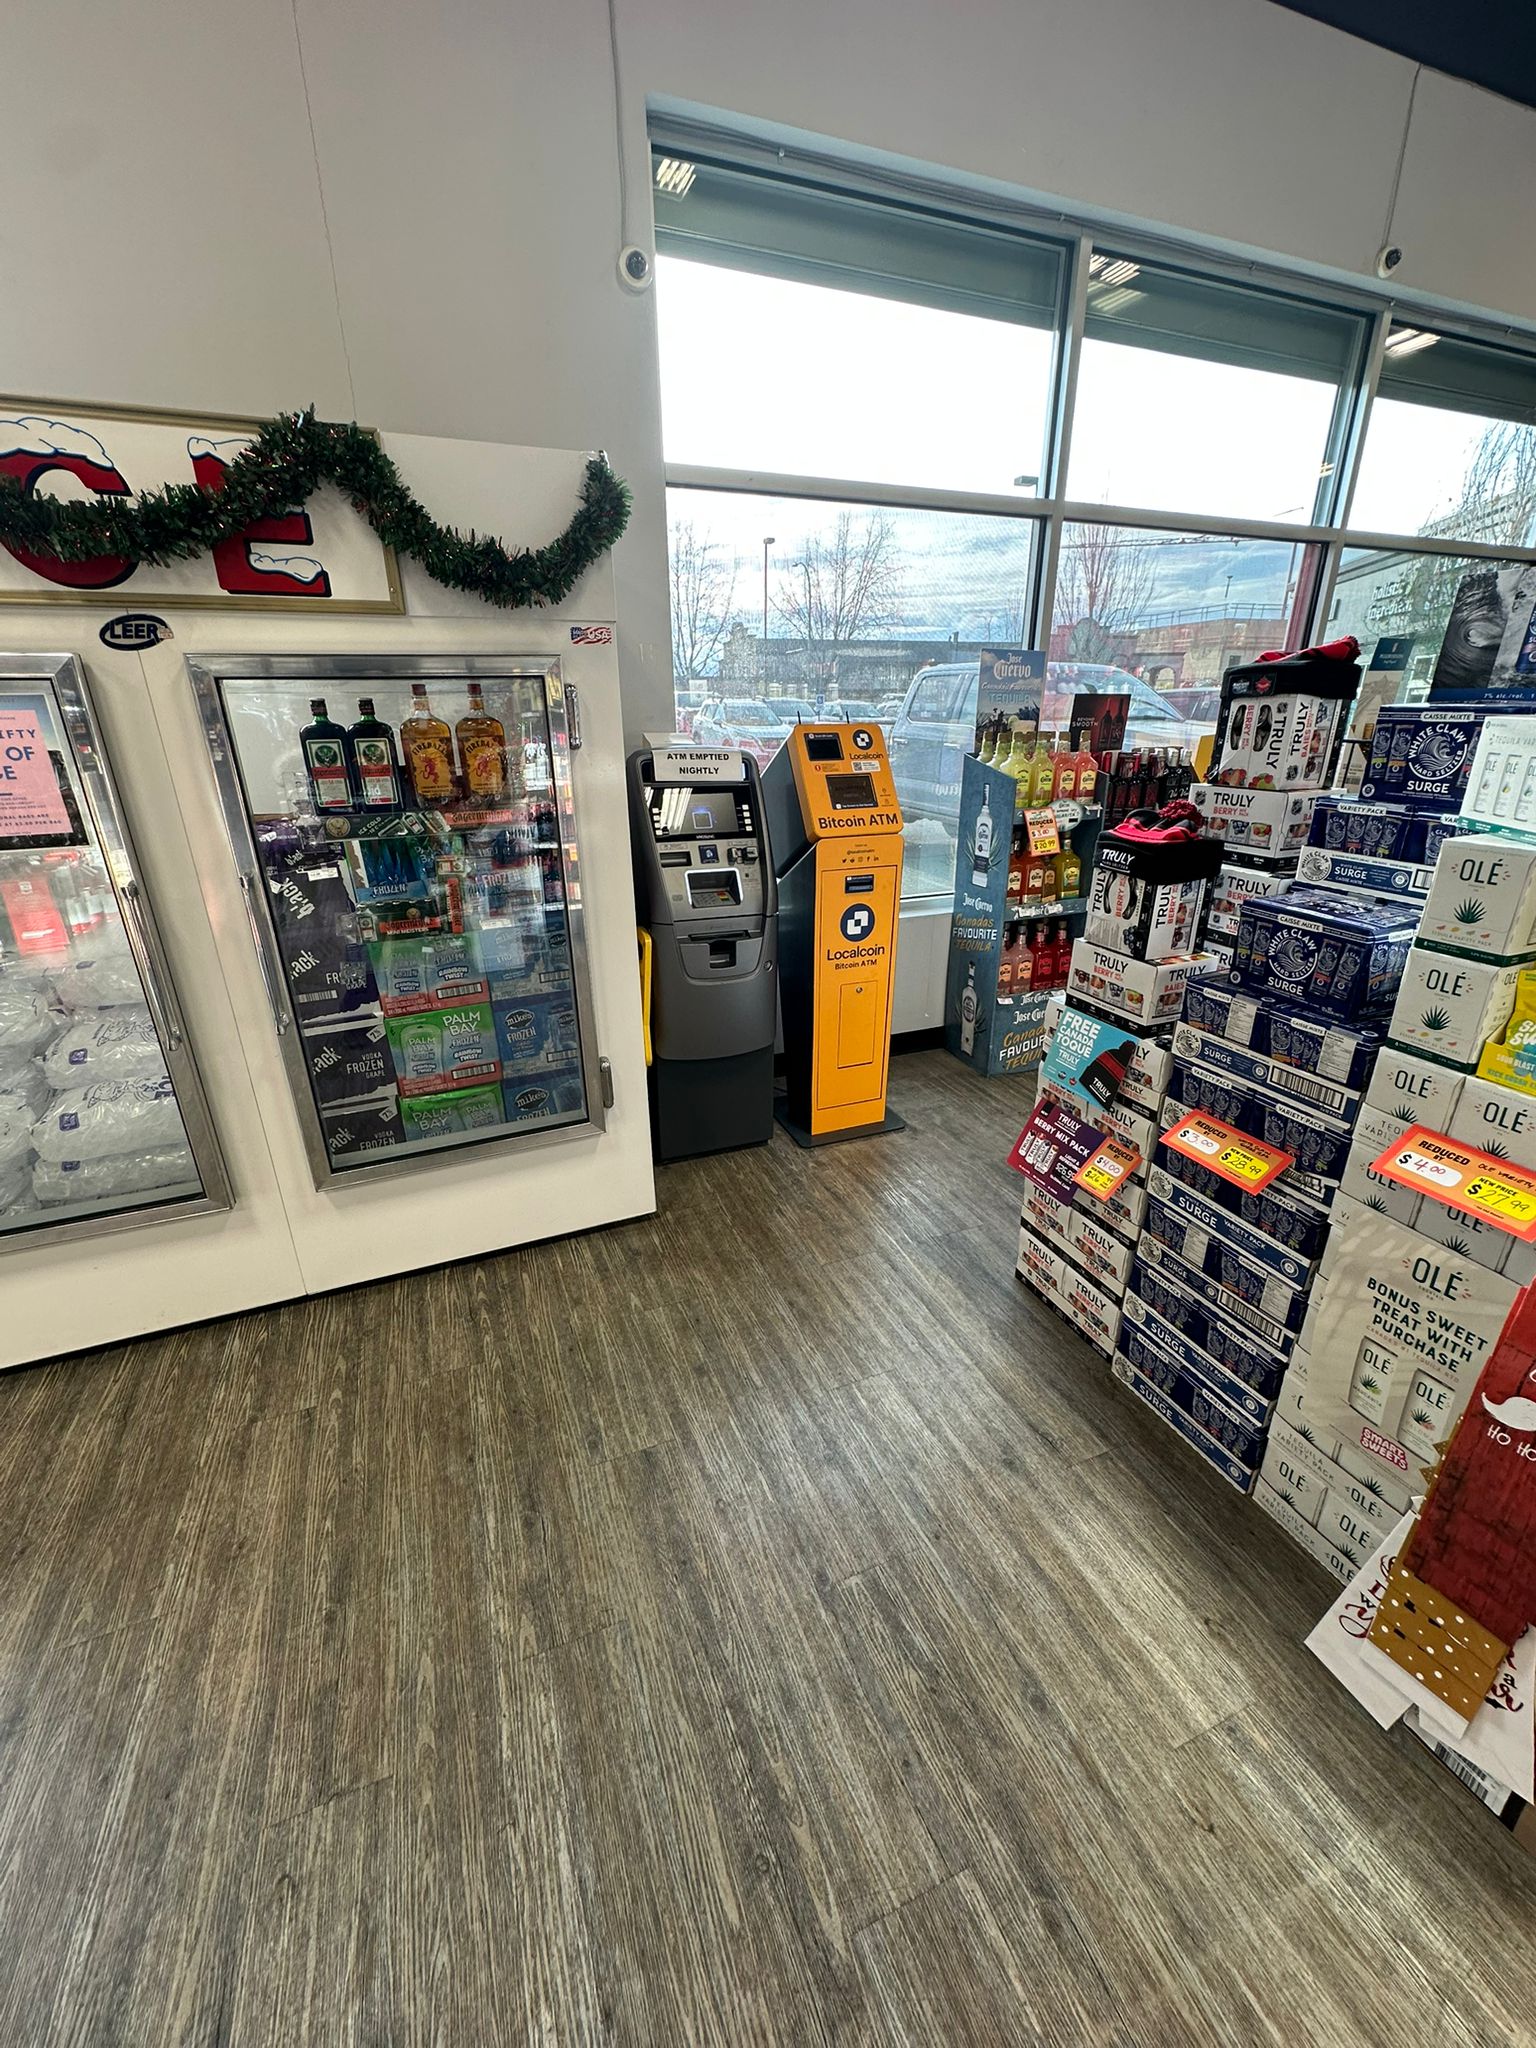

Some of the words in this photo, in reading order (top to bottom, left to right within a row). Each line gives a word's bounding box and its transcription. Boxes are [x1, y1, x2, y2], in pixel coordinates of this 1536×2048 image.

[109, 621, 159, 644] LEER
[1007, 653, 1023, 664] Jose
[993, 661, 1031, 680] Cuervo
[989, 693, 1031, 704] TEQUILA
[1244, 705, 1255, 736] BERRY
[1423, 713, 1449, 721] CAISSE
[1449, 713, 1472, 721] MIXTE
[1290, 702, 1310, 756] TRULY
[1266, 717, 1288, 770] TRULY
[1408, 727, 1433, 759] WHITE
[1436, 723, 1467, 743] CLAW
[5, 746, 35, 761] OF
[689, 753, 729, 761] EMPTIED
[849, 751, 885, 760] Localcoin
[1414, 763, 1433, 778] HARD
[1435, 749, 1463, 777] SELTZER
[679, 767, 720, 775] NIGHTLY
[1407, 780, 1450, 794] SURGE
[1214, 792, 1255, 808] TRULY
[1340, 804, 1366, 814] VARIETY
[1366, 807, 1385, 815] PACK
[818, 816, 866, 829] Bitcoin
[869, 813, 899, 826] ATM
[1213, 807, 1238, 816] BERRY
[1029, 819, 1053, 827] REDUCED
[1102, 849, 1135, 865] TRULY
[1334, 866, 1368, 880] SURGE
[1459, 858, 1504, 886] OLÉ
[1092, 868, 1107, 912] TRULY
[1227, 876, 1271, 896] TRULY
[963, 893, 976, 906] Jose
[975, 898, 993, 912] Cuervo
[1115, 888, 1125, 917] BERRY
[1155, 884, 1172, 928] TRULY
[953, 927, 998, 940] FAVOURITE
[1280, 915, 1301, 927] CAISSE
[1301, 921, 1321, 931] MIXTE
[827, 944, 885, 961] Localcoin
[955, 940, 992, 952] TEQUILA
[1268, 930, 1289, 956] WHITE
[1290, 928, 1318, 951] CLAW
[835, 962, 859, 970] Bitcoin
[861, 959, 878, 967] ATM
[1093, 966, 1115, 979] BERRY
[1094, 951, 1129, 974] TRULY
[1169, 964, 1206, 982] TRULY
[1273, 962, 1290, 977] HARD
[1291, 957, 1315, 979] SELTZER
[1164, 981, 1185, 993] BAIES
[1267, 976, 1304, 996] SURGE
[1425, 969, 1467, 997] OLÉ
[442, 1011, 481, 1027] PALM
[1013, 1010, 1031, 1025] Jose
[1063, 1011, 1102, 1039] FREE
[450, 1022, 478, 1036] BAY
[506, 1027, 537, 1043] FROZEN
[1059, 1025, 1094, 1048] CANADA
[409, 1037, 436, 1046] PALM
[1056, 1032, 1093, 1058] TOQUE
[346, 1059, 384, 1074] FROZEN
[1058, 1049, 1080, 1066] TRULY
[1204, 1046, 1232, 1065] SURGE
[1513, 1056, 1536, 1072] BLAST
[1093, 1077, 1112, 1098] TRULY
[1121, 1080, 1144, 1095] TRULY
[1193, 1067, 1217, 1083] VARIETY
[1216, 1076, 1231, 1089] PACK
[1394, 1069, 1433, 1099] OLÉ
[412, 1107, 452, 1122] PALM
[419, 1117, 447, 1131] BAY
[1059, 1113, 1081, 1131] TRULY
[1278, 1105, 1305, 1122] VARIETY
[1305, 1115, 1323, 1130] PACK
[1482, 1101, 1529, 1134] OLÉ
[1034, 1117, 1055, 1133] BERRY
[1055, 1130, 1070, 1143] MIX
[1069, 1140, 1090, 1158] PACK
[1195, 1119, 1228, 1140] REDUCED
[1107, 1143, 1134, 1162] REDUCED
[1239, 1152, 1254, 1162] PRICE
[1418, 1140, 1471, 1166] REDUCED
[1433, 1154, 1445, 1162] BY
[1479, 1177, 1496, 1187] NEW
[1495, 1183, 1518, 1197] PRICE
[1033, 1186, 1061, 1212] TRULY
[1278, 1198, 1296, 1211] PACK
[1103, 1206, 1124, 1224] TRULY
[1179, 1197, 1218, 1229] SURGE
[1082, 1222, 1114, 1252] TRULY
[1224, 1219, 1249, 1240] VARIETY
[1248, 1234, 1267, 1250] PACK
[1028, 1239, 1054, 1266] TRULY
[1163, 1256, 1188, 1279] SURGE
[1149, 1270, 1168, 1287] VARIETY
[1167, 1284, 1181, 1298] PACK
[1411, 1256, 1464, 1302] OLÉ
[1075, 1279, 1107, 1311] TRULY
[1367, 1276, 1421, 1316] BONUS
[1426, 1309, 1489, 1351] SWEET
[1151, 1322, 1187, 1356] SURGE
[1217, 1322, 1242, 1344] VARIETY
[1240, 1339, 1257, 1354] PACK
[1372, 1295, 1422, 1332] TREAT
[1427, 1327, 1473, 1363] WITH
[1372, 1313, 1461, 1374] PURCHASE
[1191, 1351, 1216, 1376] VARIETY
[1214, 1369, 1230, 1385] PACK
[1362, 1347, 1392, 1376] OLÉ
[1138, 1383, 1173, 1419] SURGE
[1203, 1388, 1225, 1409] VARIETY
[1223, 1406, 1240, 1424] PACK
[1415, 1381, 1448, 1411] OLÉ
[1178, 1415, 1200, 1438] VARIETY
[1199, 1433, 1215, 1450] PACK
[1363, 1427, 1405, 1459] SMART
[1487, 1424, 1512, 1447] HO
[1361, 1437, 1409, 1470] SWEETS
[1278, 1460, 1307, 1493] OLÉ
[1350, 1487, 1377, 1518] OLÉ
[1339, 1514, 1371, 1550] OLÉ
